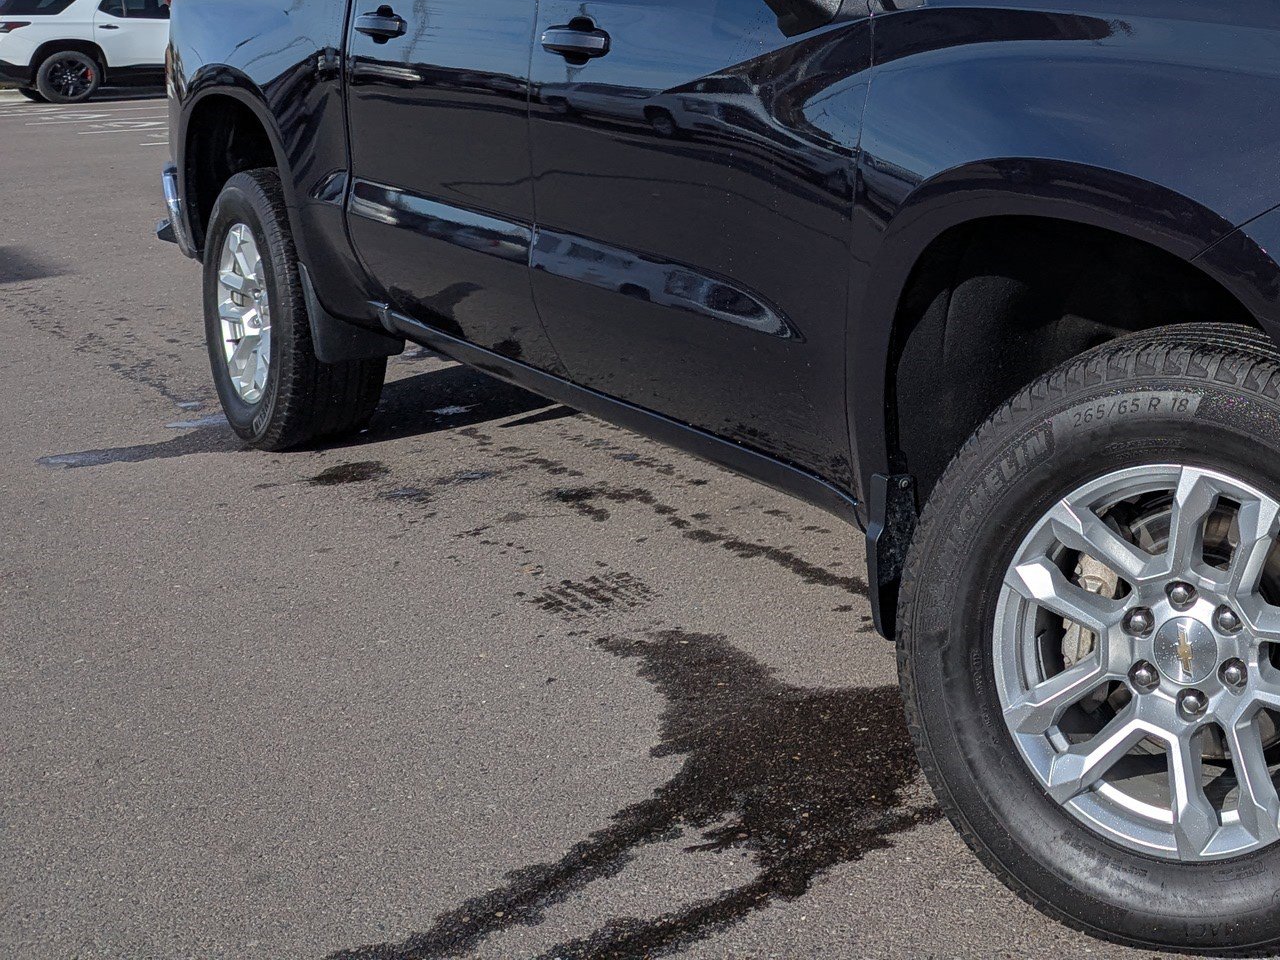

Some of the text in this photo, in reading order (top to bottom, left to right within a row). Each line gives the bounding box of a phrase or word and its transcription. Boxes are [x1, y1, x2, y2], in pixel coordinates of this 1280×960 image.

[1073, 397, 1190, 428] 265/65 R 18
